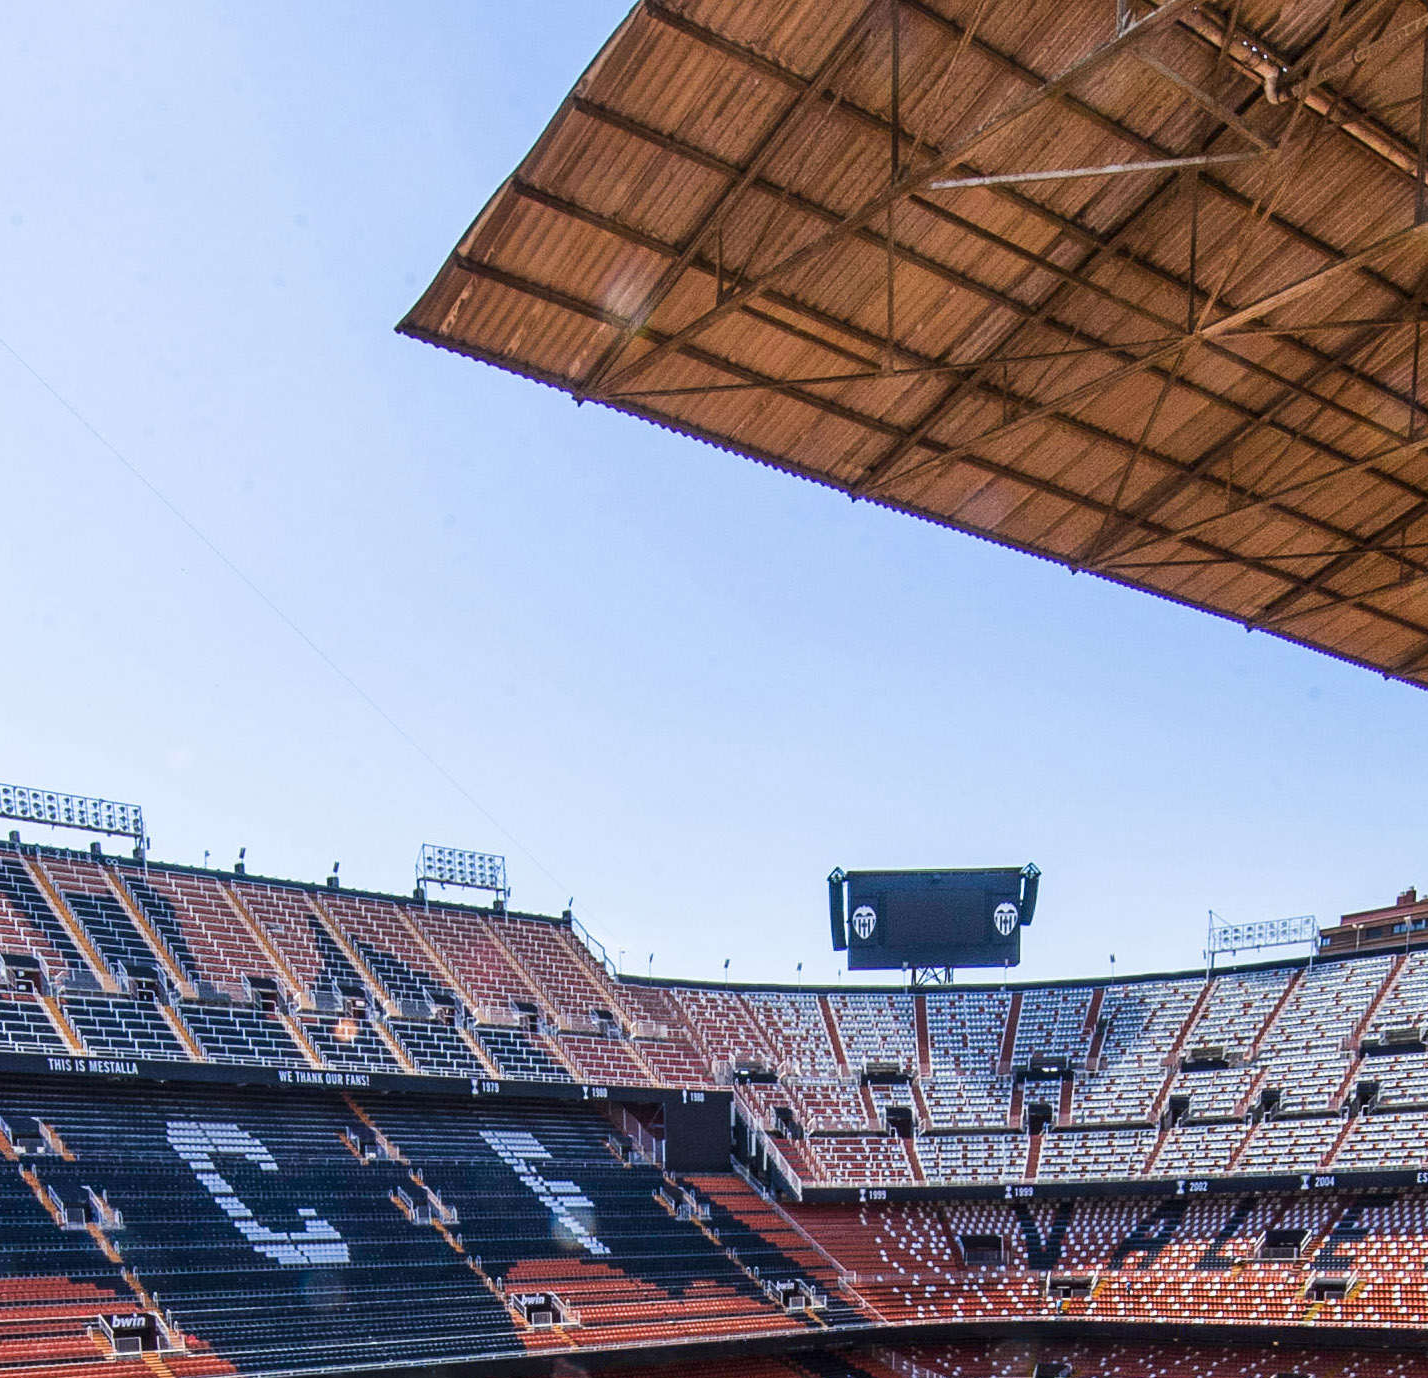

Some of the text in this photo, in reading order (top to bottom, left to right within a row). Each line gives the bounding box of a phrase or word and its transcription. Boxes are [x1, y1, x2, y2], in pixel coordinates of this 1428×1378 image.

[47, 1058, 139, 1075] THIS IS MESTALLA
[278, 1070, 370, 1087] WE THANK OUR FANS!
[112, 1312, 146, 1328] bwin
